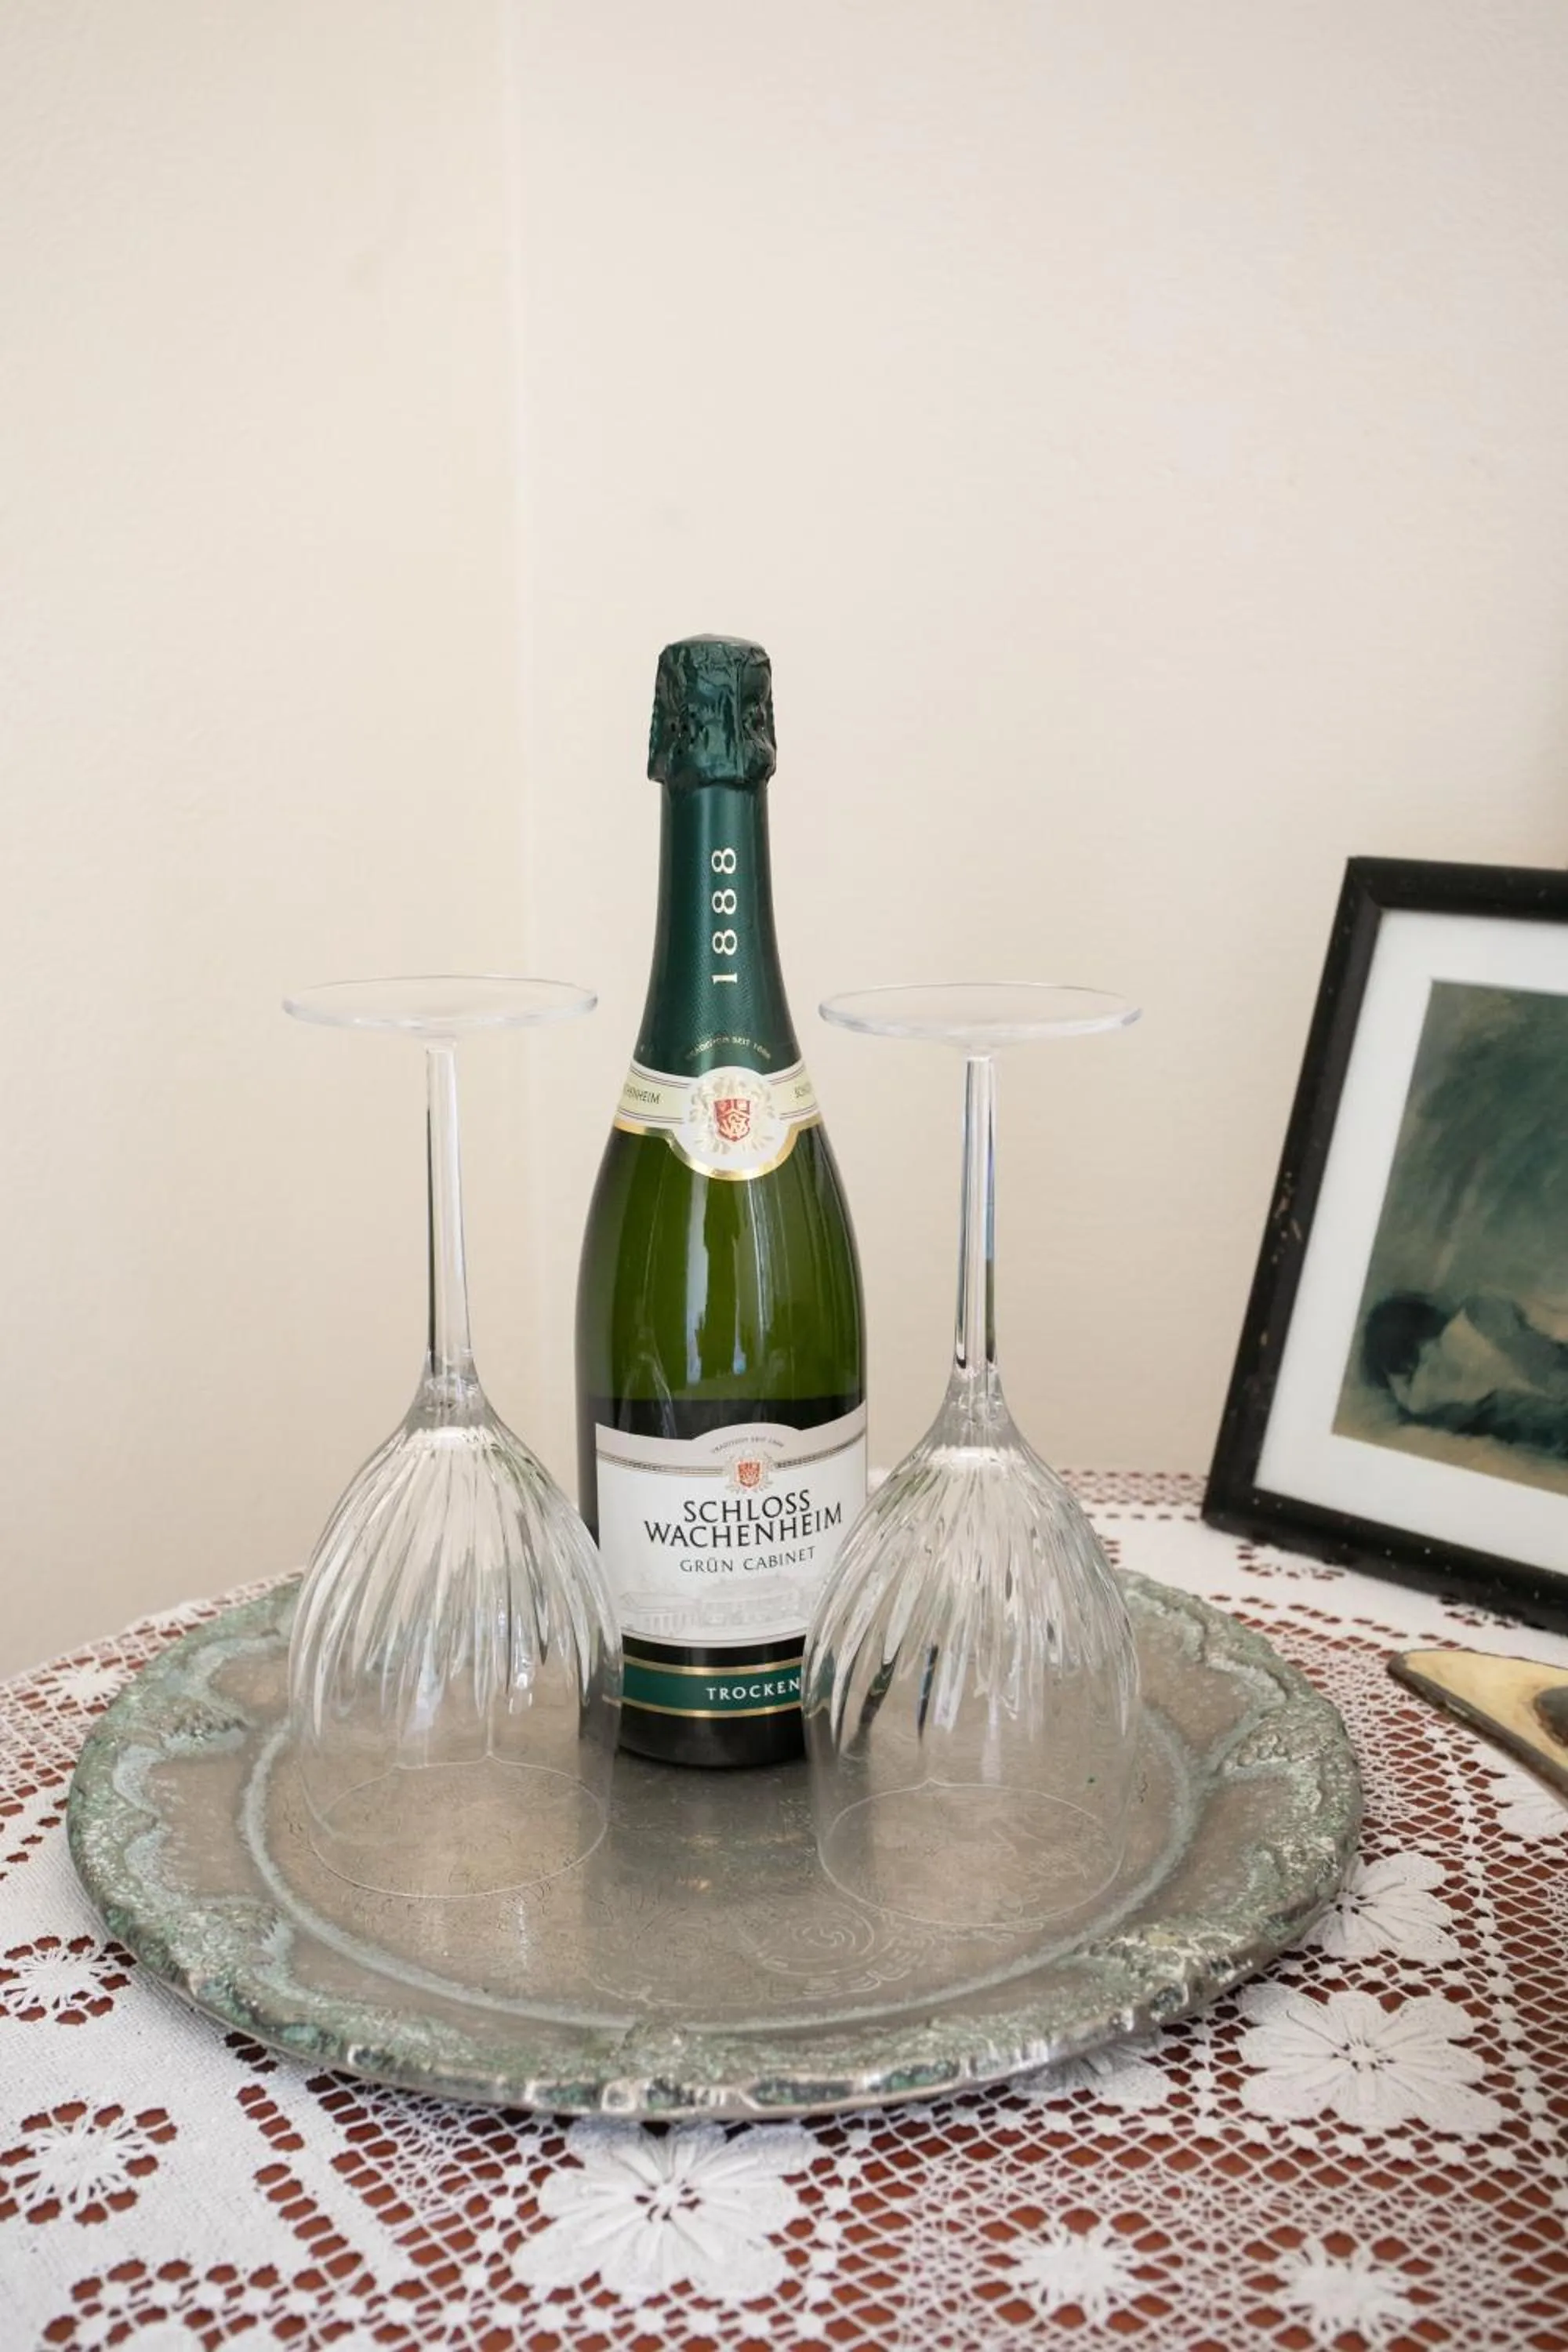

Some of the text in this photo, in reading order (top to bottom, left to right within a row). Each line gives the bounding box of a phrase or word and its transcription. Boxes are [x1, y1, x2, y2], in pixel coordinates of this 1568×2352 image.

[711, 848, 738, 985] 1888
[684, 1489, 811, 1523] SCHLOSS
[644, 1501, 842, 1548] WACHENHEIM
[680, 1545, 816, 1573] GRÜN CABINET
[706, 1677, 800, 1700] TROCKEN
